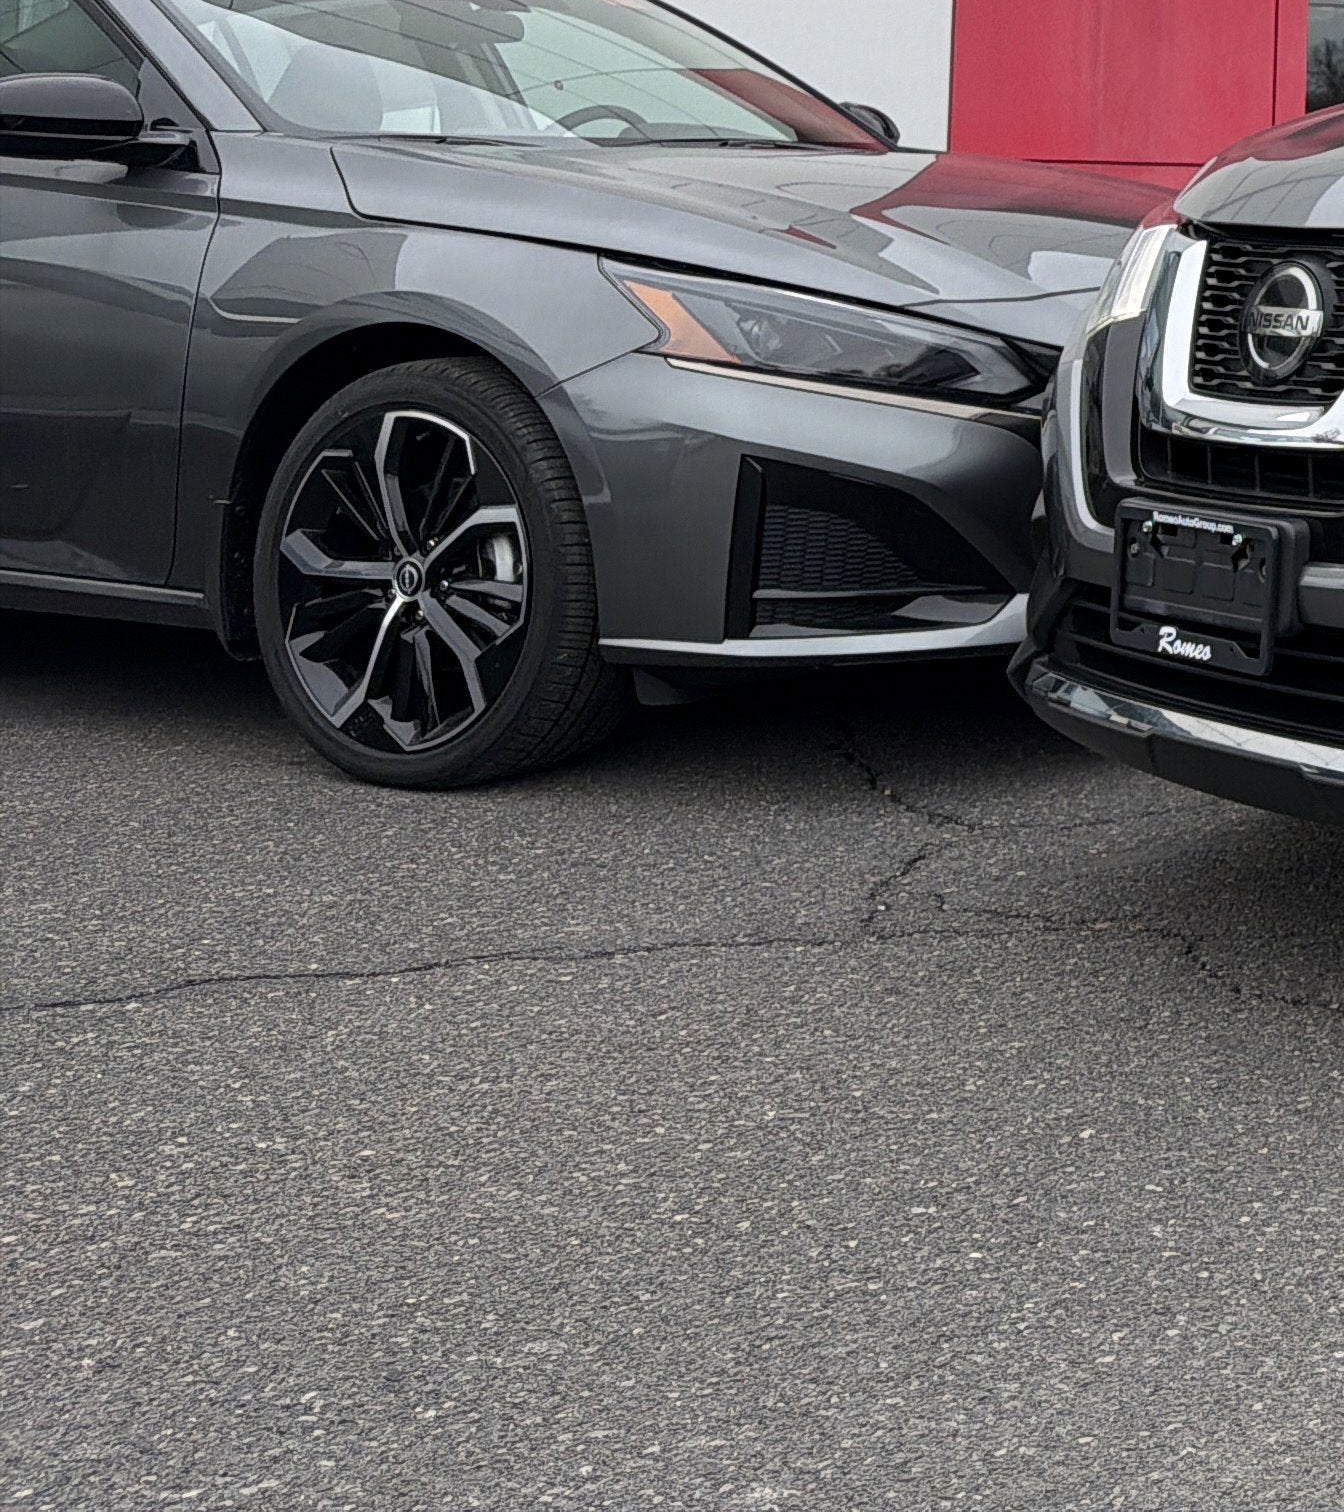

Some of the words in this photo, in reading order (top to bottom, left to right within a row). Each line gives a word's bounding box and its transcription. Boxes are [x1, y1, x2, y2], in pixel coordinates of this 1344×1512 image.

[1249, 311, 1310, 331] NISSAN
[1153, 510, 1234, 535] RomeoAutoGroup.com
[1157, 626, 1213, 662] Romeo
